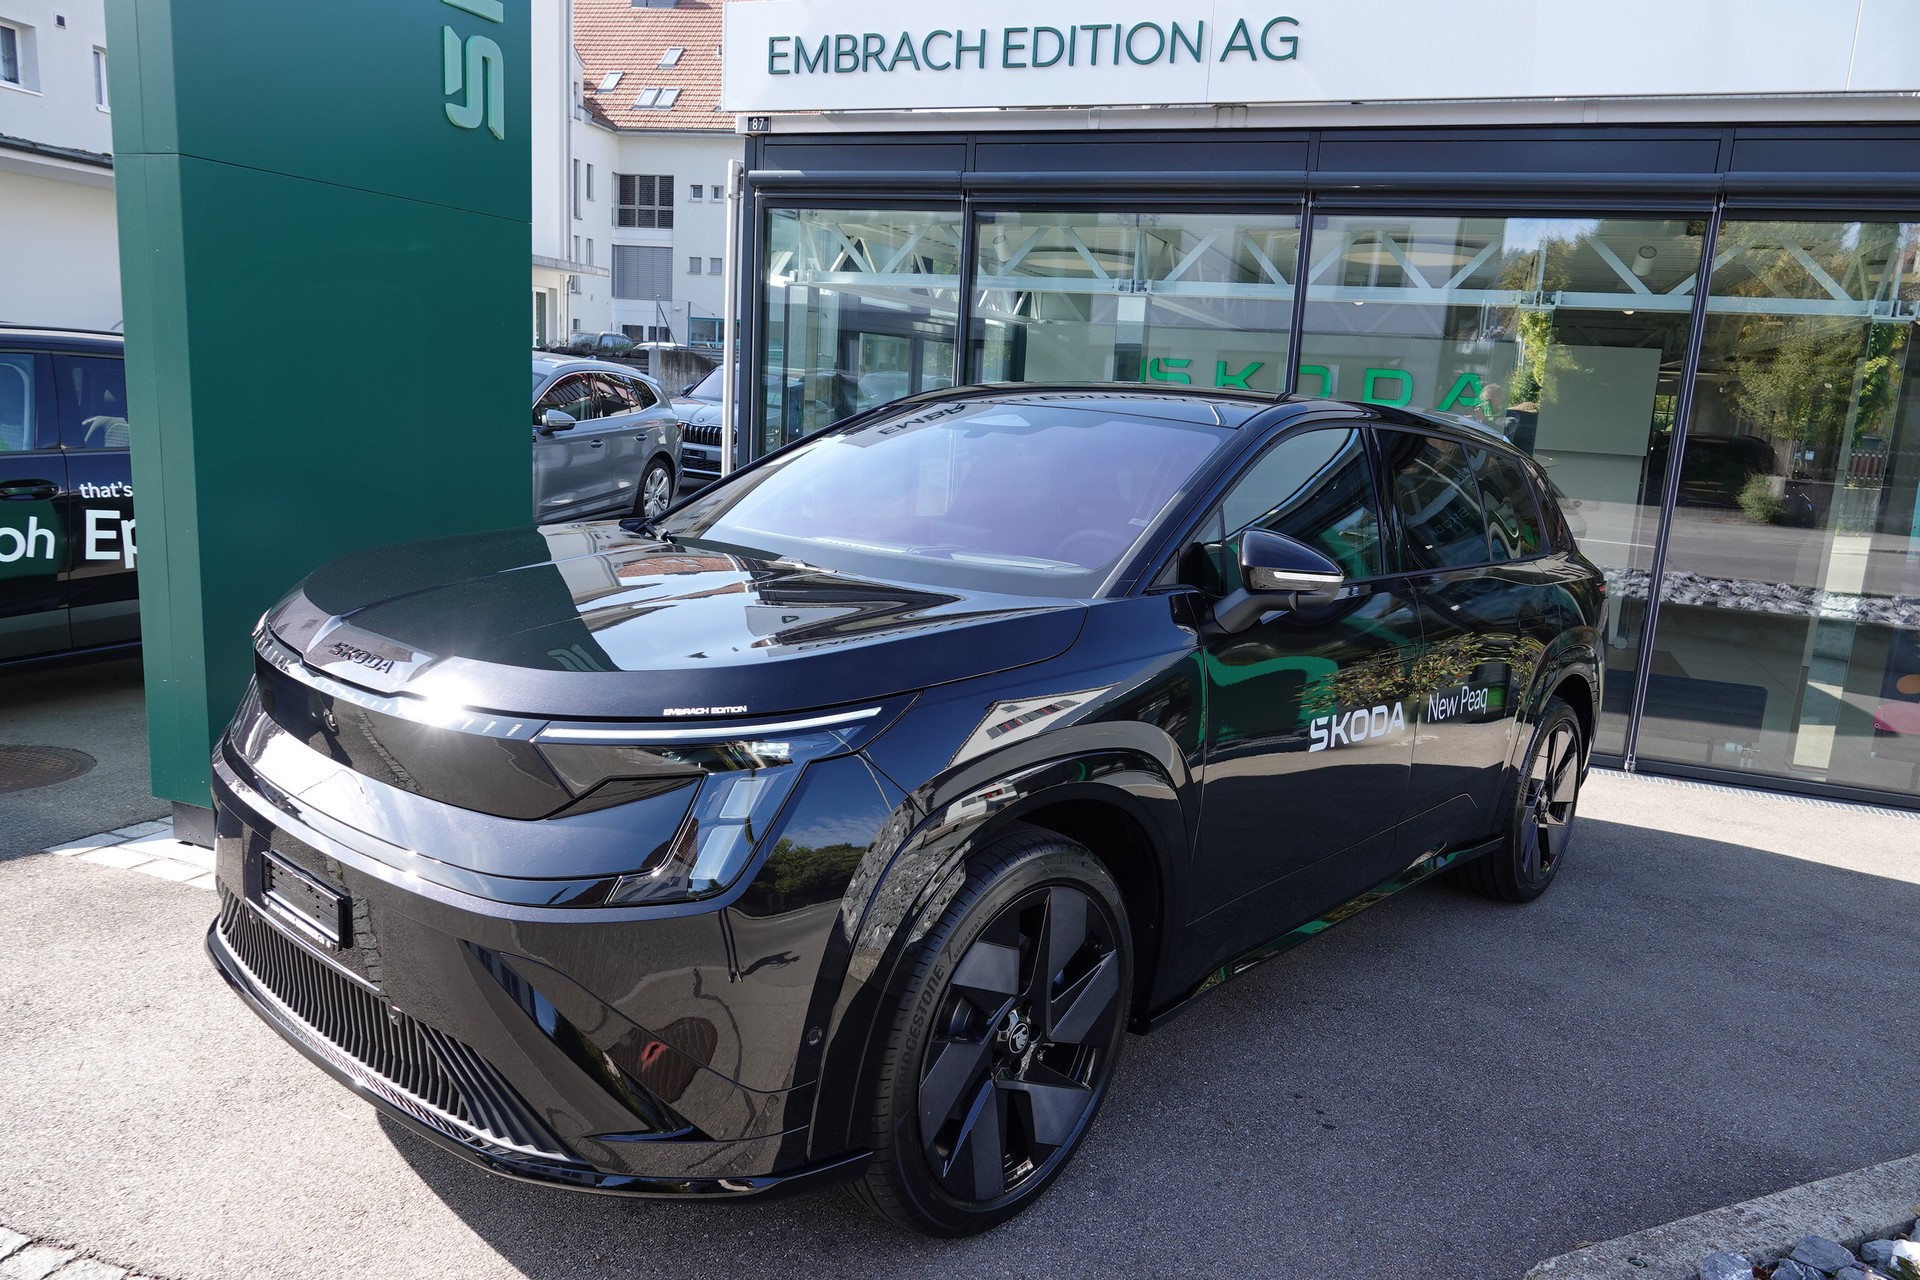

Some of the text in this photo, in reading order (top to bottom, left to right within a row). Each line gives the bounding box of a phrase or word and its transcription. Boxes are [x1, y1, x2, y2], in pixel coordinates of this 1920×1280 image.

[768, 16, 1300, 75] EMBRACH EDITION AG
[752, 117, 765, 130] 87
[79, 482, 133, 498] that's
[663, 705, 747, 716] EMBRACH EDITION
[1427, 686, 1489, 723] New Peaq
[897, 964, 945, 1096] RIDGESTONE
